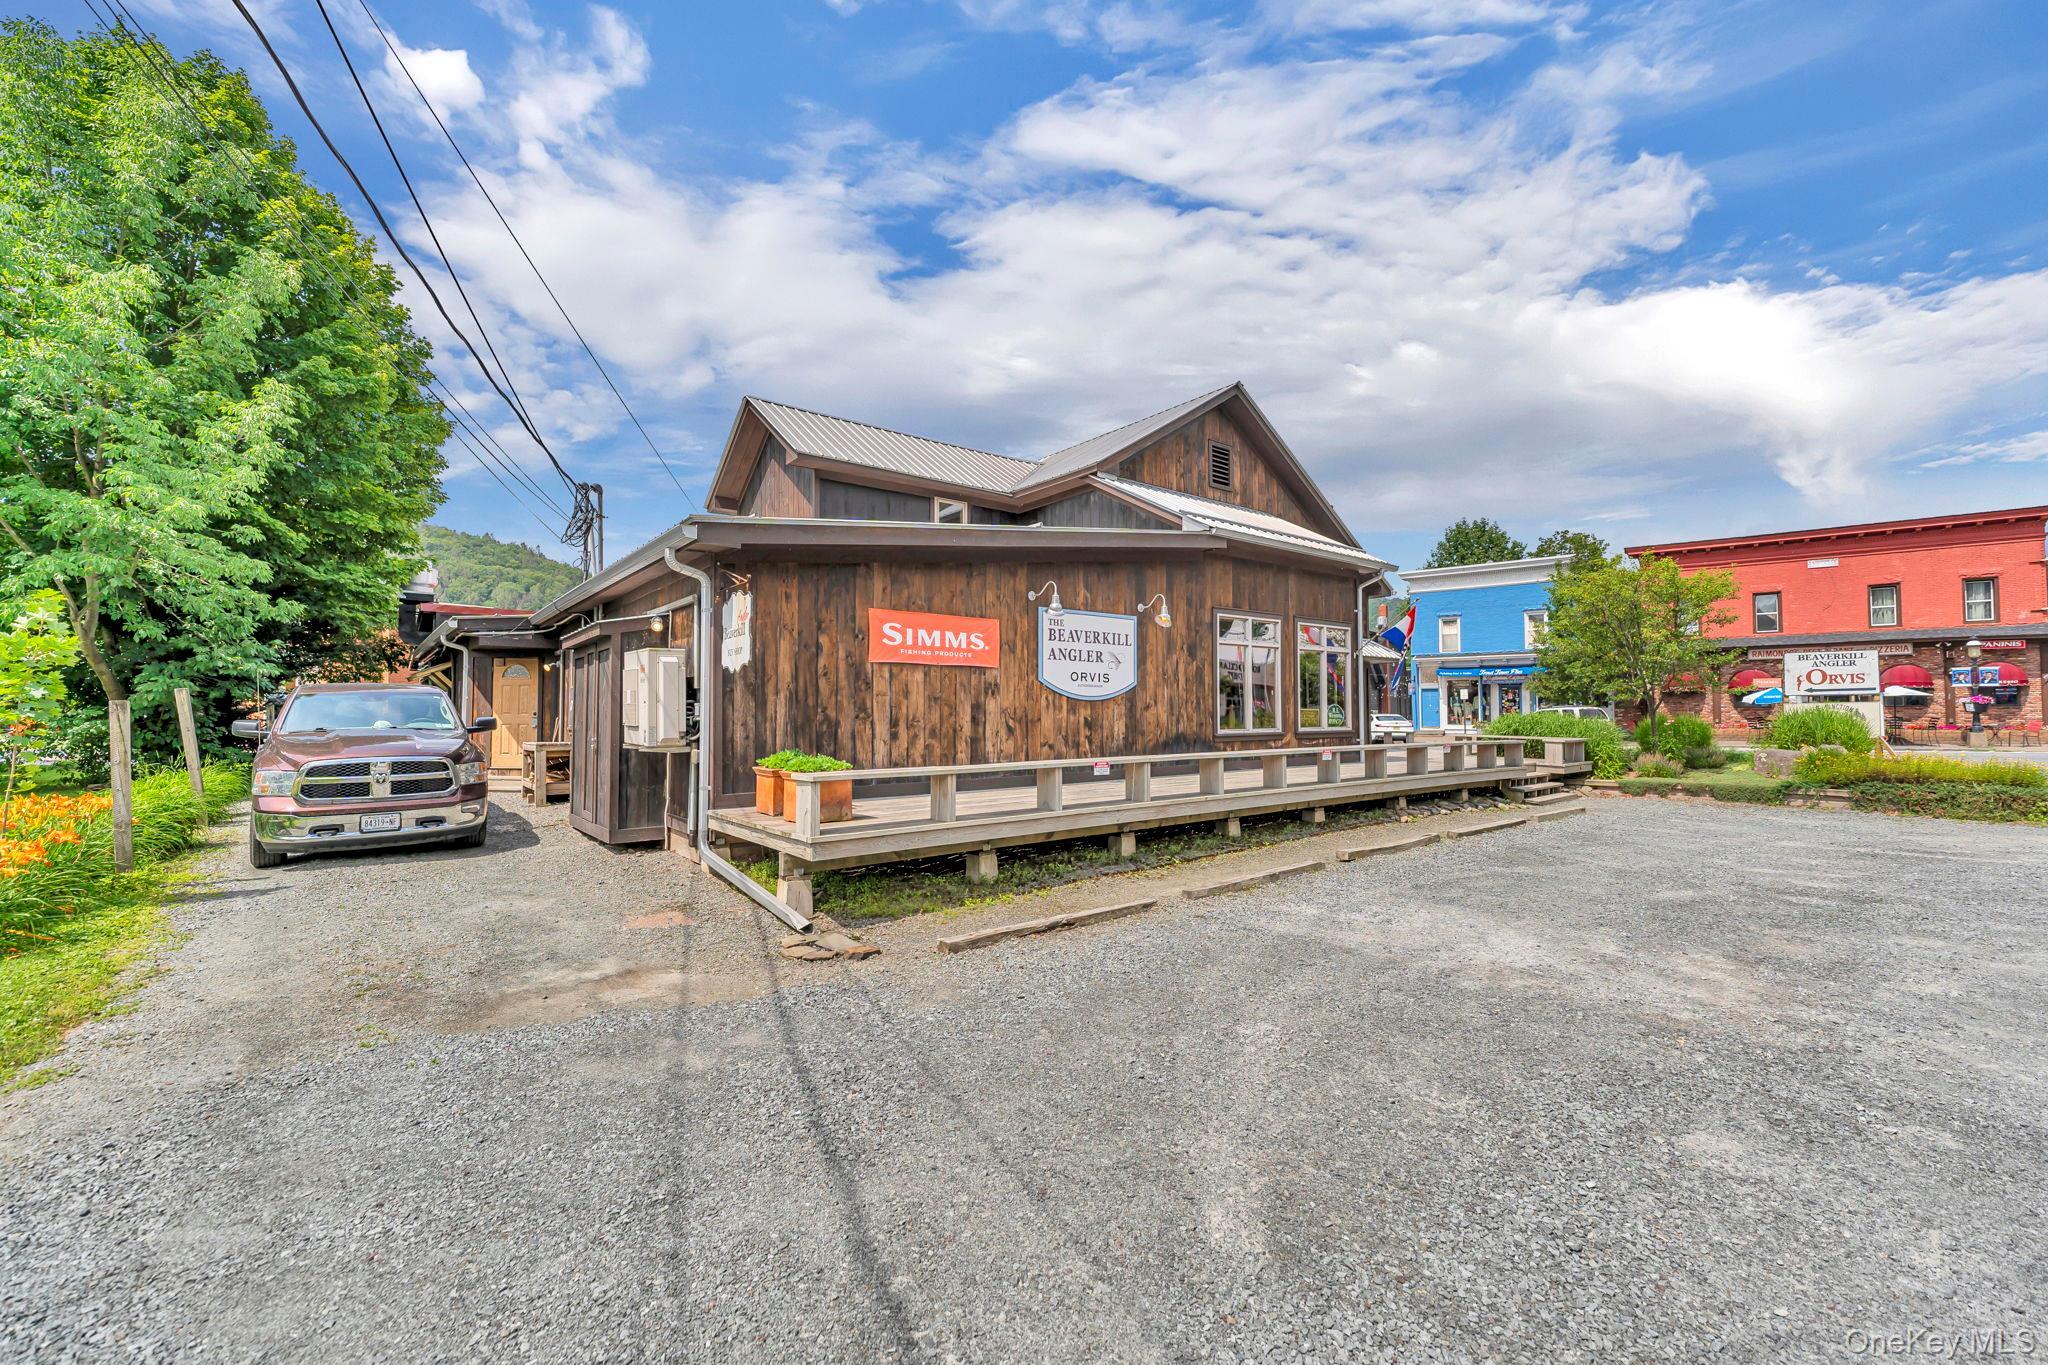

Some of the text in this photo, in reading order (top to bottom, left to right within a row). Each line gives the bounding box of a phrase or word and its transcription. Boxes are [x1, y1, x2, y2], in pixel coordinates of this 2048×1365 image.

[1047, 618, 1065, 627] THE
[1047, 628, 1132, 647] BEAVERKILL
[900, 648, 972, 658] FISHING PRODUCTS
[1047, 647, 1104, 663] ANGLER
[1798, 652, 1867, 662] BEAVERKILL
[1811, 659, 1857, 667] ANGLER
[1070, 671, 1110, 683] ORVIS
[1805, 668, 1866, 685] ORVIS
